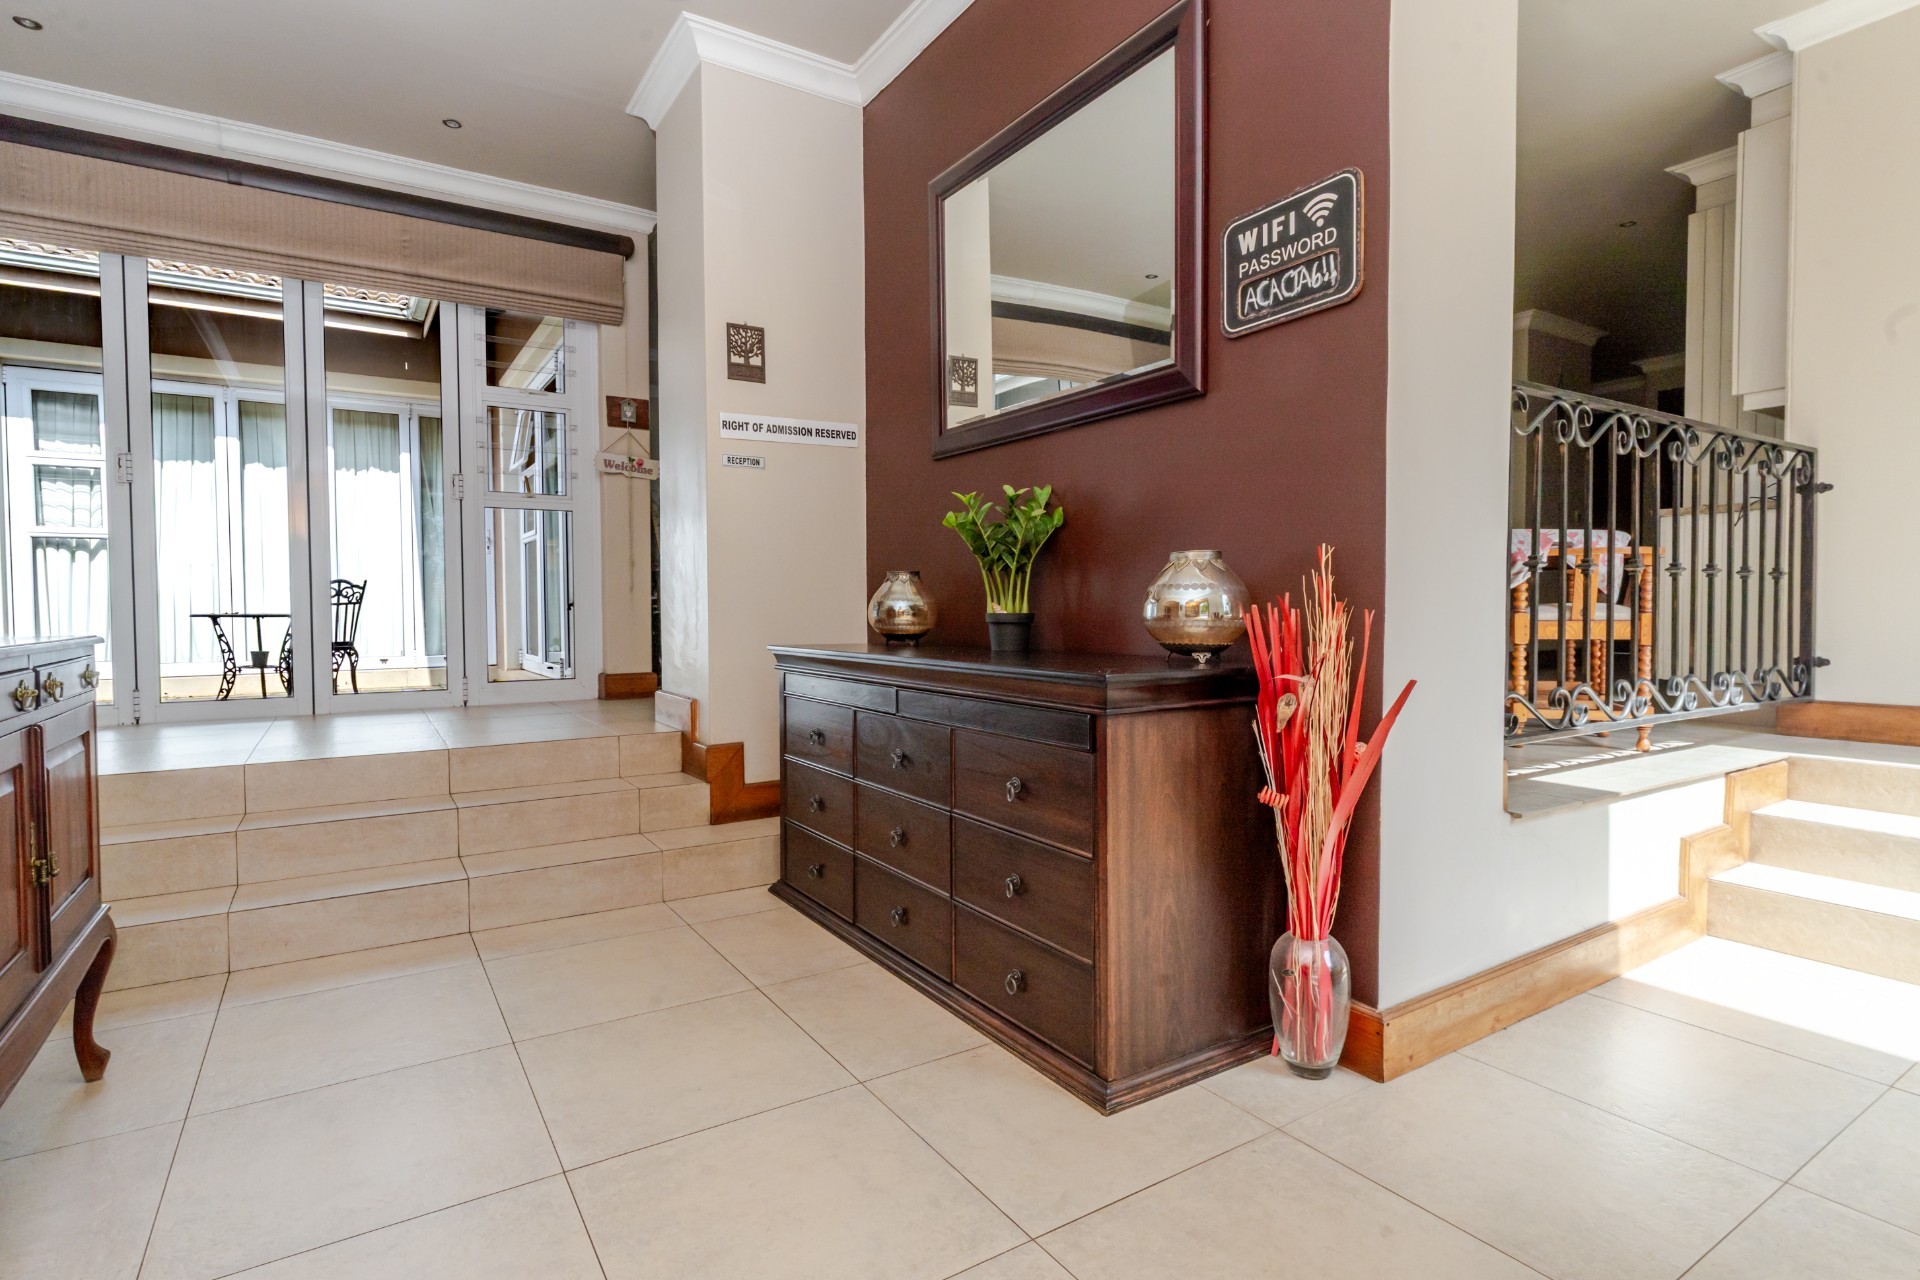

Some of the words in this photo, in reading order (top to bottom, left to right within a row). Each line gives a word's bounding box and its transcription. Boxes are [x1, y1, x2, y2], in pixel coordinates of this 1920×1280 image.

[1238, 211, 1296, 255] WIFI
[1239, 227, 1338, 278] PASSWORD
[722, 420, 750, 432] RIGHT
[752, 423, 764, 433] OF
[766, 424, 813, 437] ADMISSION
[815, 428, 857, 441] RESERVED
[603, 458, 654, 475] Welcome
[727, 456, 760, 466] RECEPTION
